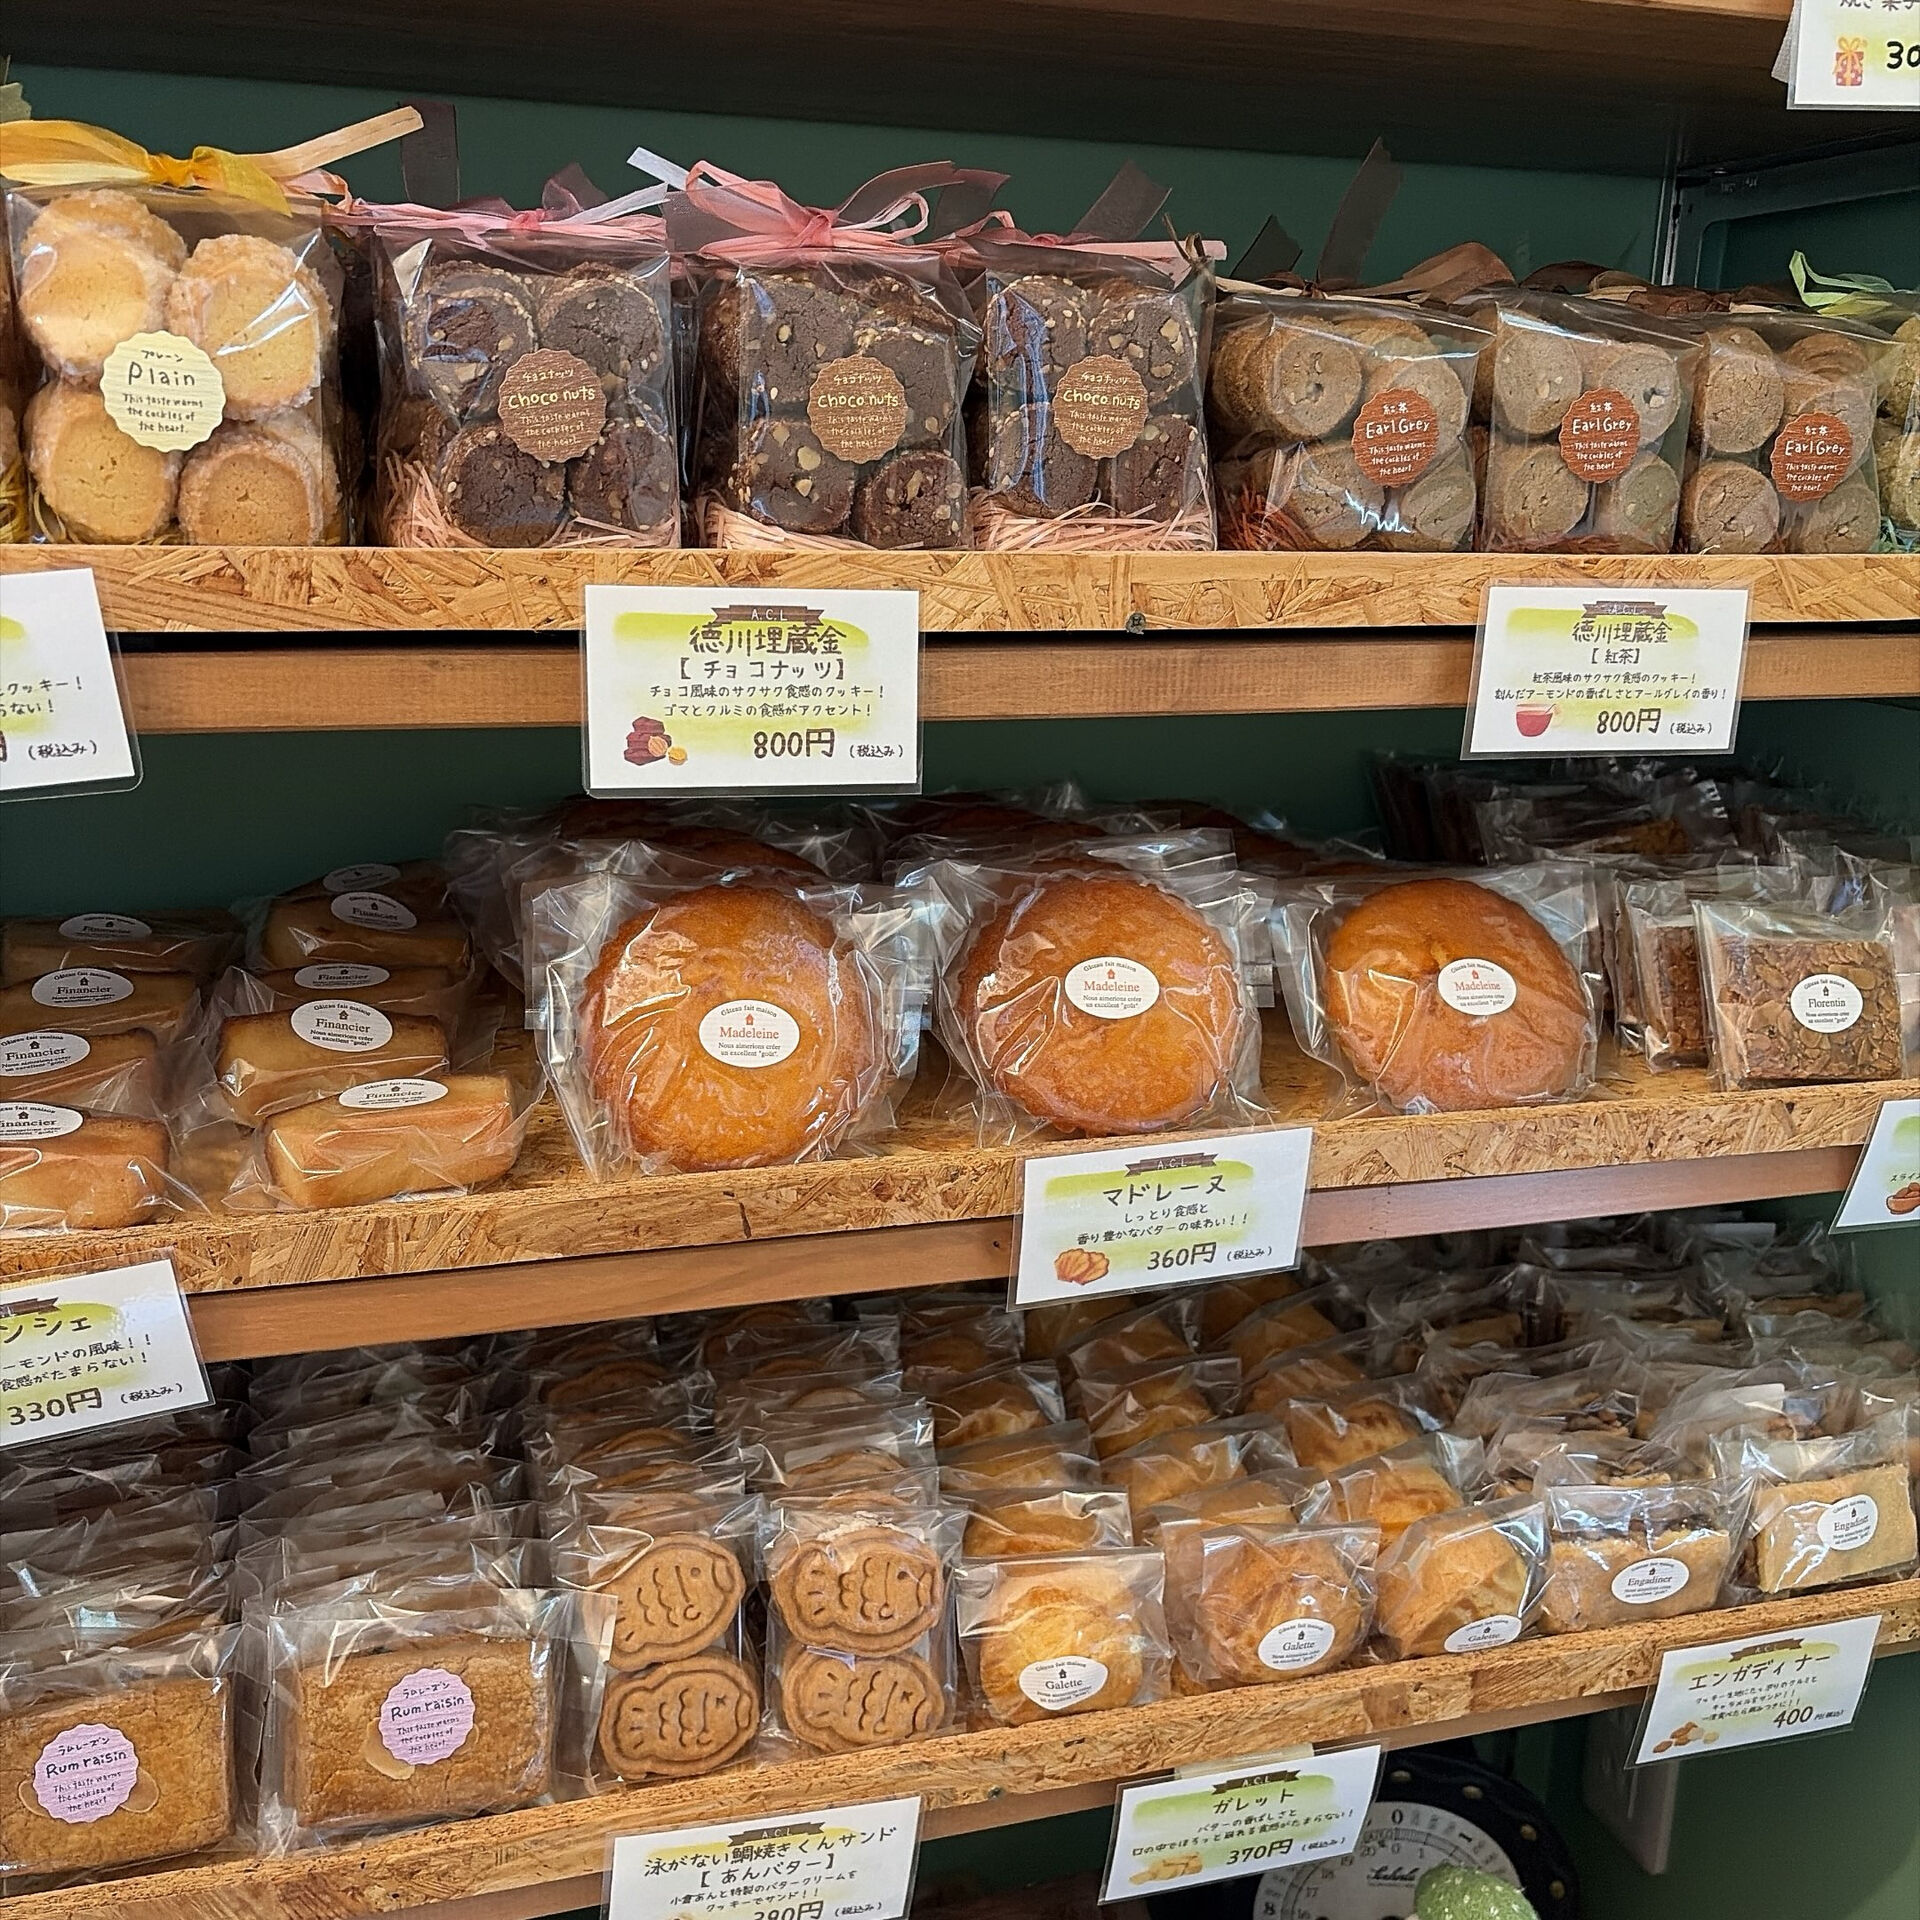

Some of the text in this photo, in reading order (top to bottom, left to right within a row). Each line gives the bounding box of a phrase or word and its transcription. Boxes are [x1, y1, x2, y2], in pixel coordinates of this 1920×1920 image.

[128, 361, 195, 386] Plain
[122, 393, 203, 408] This taste warms
[508, 385, 596, 409] Choco nuts
[817, 392, 899, 408] Choco nuts
[1063, 389, 1141, 410] Choco nuts
[127, 407, 195, 421] the cockles of
[1383, 402, 1409, 415] 紅茶
[1589, 401, 1613, 413] 紅茶
[139, 421, 188, 433] the heart.
[1366, 418, 1430, 439] Earl Grey
[1572, 417, 1632, 435] Earl Grey
[1804, 425, 1828, 436] 紅茶
[1785, 440, 1845, 456] Earl Grey
[689, 623, 847, 656] 徳川埋蔵金
[1572, 620, 1672, 645] 徳川埋蔵金
[1591, 648, 1640, 665] 【紅茶】
[650, 684, 885, 699] チョコ風味のサクサク食感のクッキー！
[664, 703, 872, 718] ゴマとクルミの食感がアクセント！
[1596, 708, 1713, 735] 800円 (税込み)
[754, 728, 904, 759] 800円 (税込み)
[57, 985, 112, 995] Financier
[1083, 980, 1140, 992] Madeleine
[1455, 981, 1501, 992] Madeleine
[1808, 997, 1846, 1008] Florentin
[315, 1018, 371, 1033] Financier
[719, 1026, 779, 1039] Madeleine
[6, 1048, 66, 1061] Financier
[366, 1090, 425, 1099] Financier
[0, 1119, 57, 1128] inancier
[1890, 1171, 1920, 1182] スライ
[1103, 1175, 1226, 1207] マドレーヌ
[1125, 1203, 1208, 1223] しっとり食感と
[1077, 1213, 1248, 1246] 香り豊かなバターの味わい！！
[1147, 1242, 1272, 1271] 360円 (税込み)
[6, 1383, 183, 1426] 330円 (税込み)
[1282, 1641, 1315, 1651] Galette
[1688, 1654, 1831, 1691] エンガディナー
[1045, 1679, 1083, 1690] Galette
[391, 1696, 464, 1722] Rum raisin
[1773, 1706, 1814, 1728] 400
[58, 1736, 110, 1756] ラムレーズン
[46, 1751, 127, 1779] Rum raisin
[1213, 1788, 1294, 1815] ガレット
[645, 1827, 897, 1877] 泳がない鯛焼きくんサンド
[1226, 1838, 1293, 1866] 370円
[700, 1853, 835, 1888] 【あんバター】
